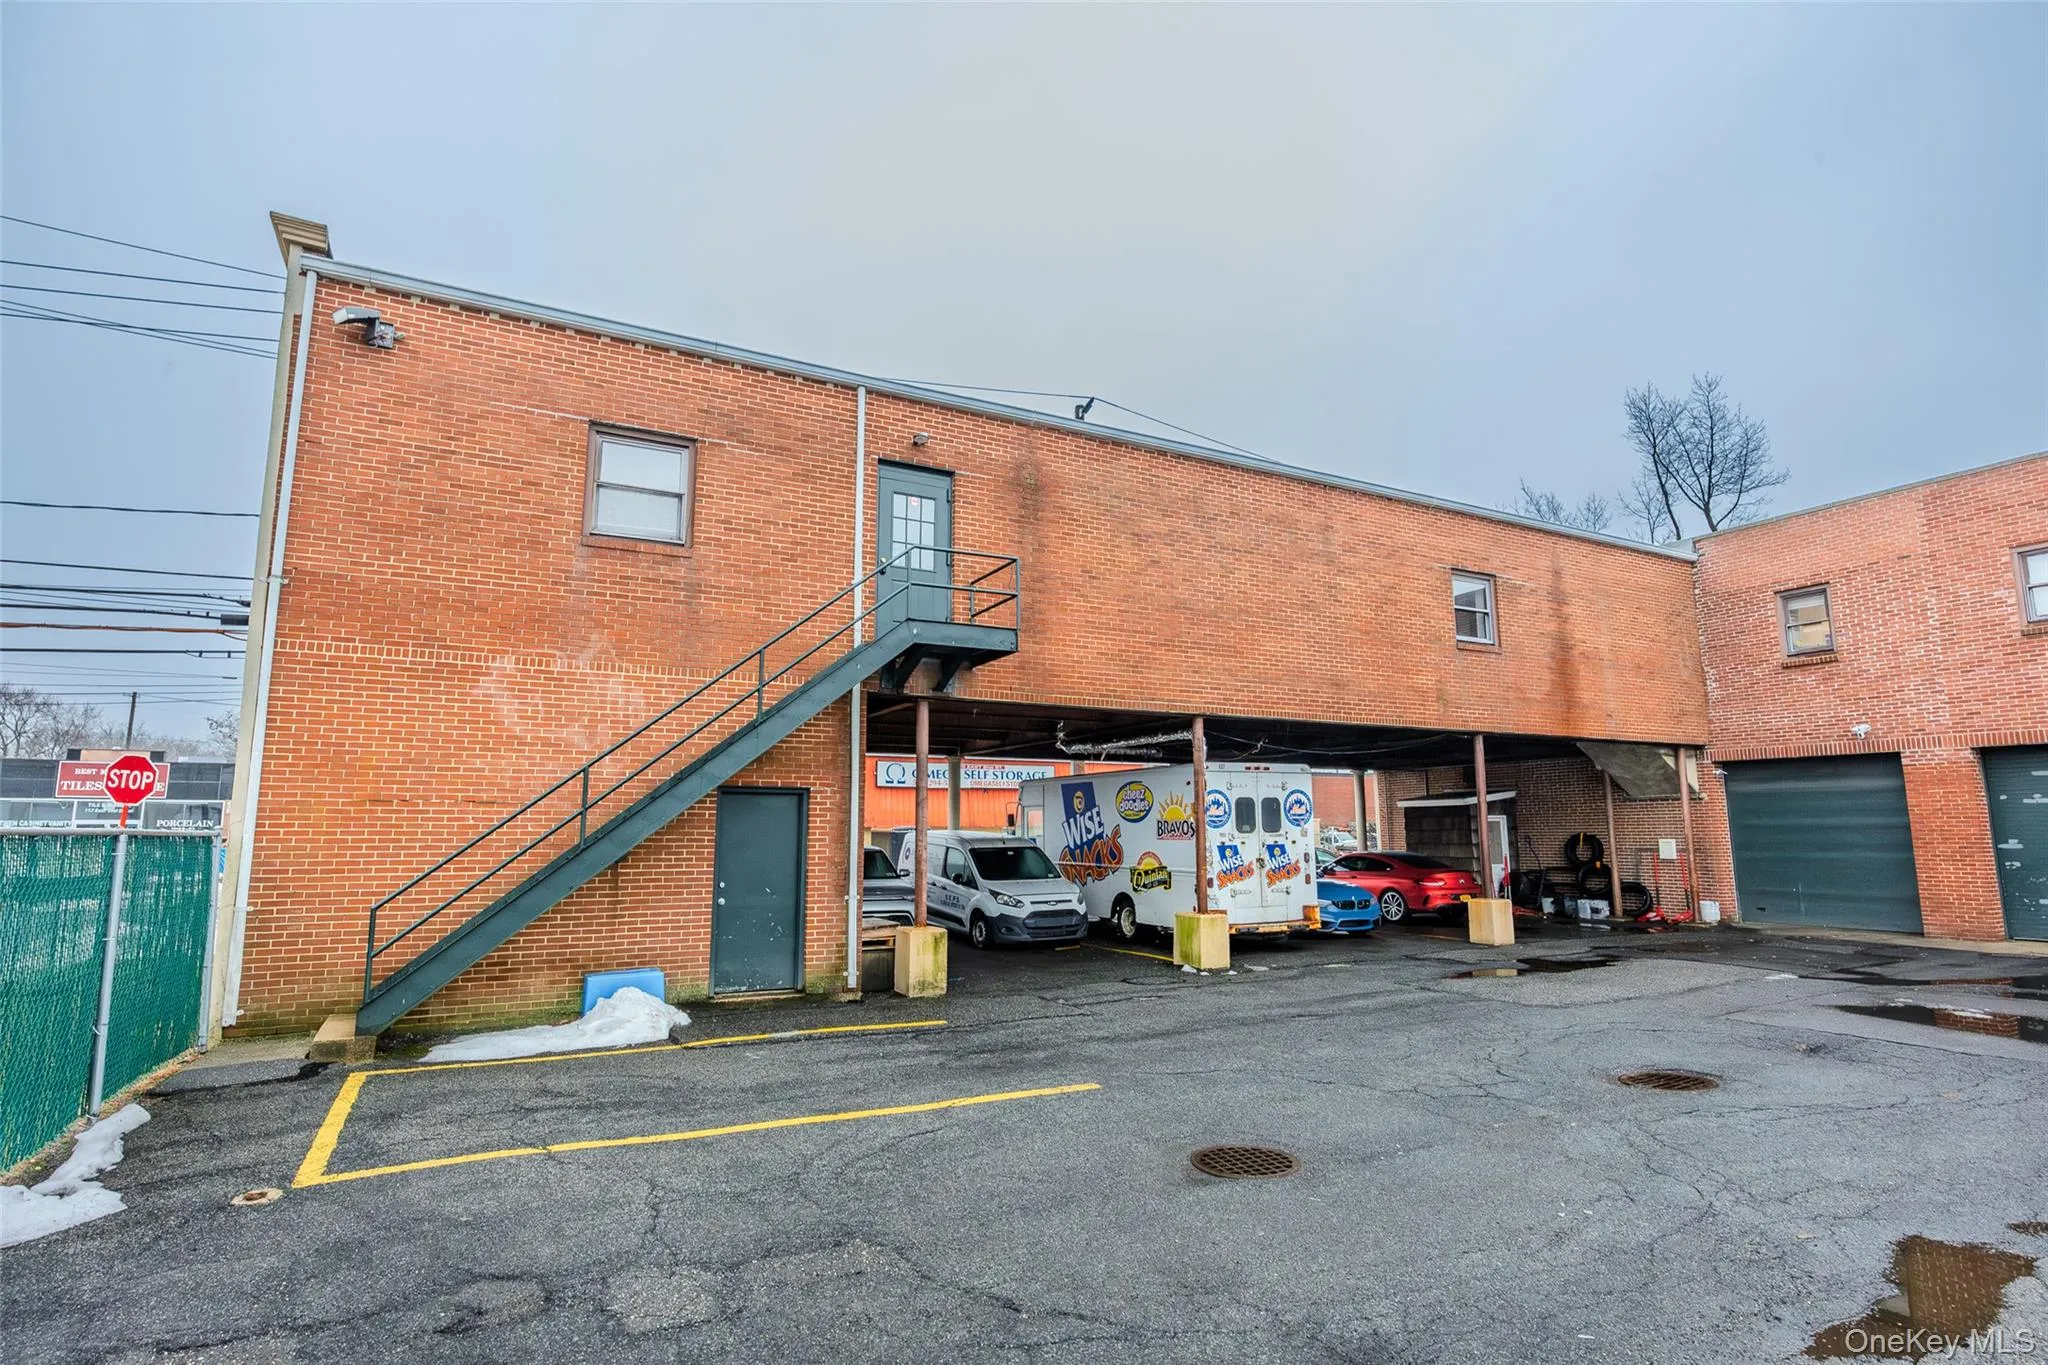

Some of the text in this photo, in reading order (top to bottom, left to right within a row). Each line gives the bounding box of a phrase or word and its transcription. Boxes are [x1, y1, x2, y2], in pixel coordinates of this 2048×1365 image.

[107, 768, 154, 790] STOP
[964, 769, 989, 780] SELF
[992, 770, 1047, 781] STORAGE
[61, 780, 103, 791] TILES
[1122, 785, 1145, 800] cheez
[1119, 800, 1150, 812] doodles
[156, 819, 214, 827] PORCELAIN
[1062, 805, 1104, 849] WISE
[1157, 820, 1196, 838] BRAVOS
[1059, 824, 1124, 887] SNACKS
[1219, 854, 1245, 873] WISE
[1268, 853, 1292, 870] WISE
